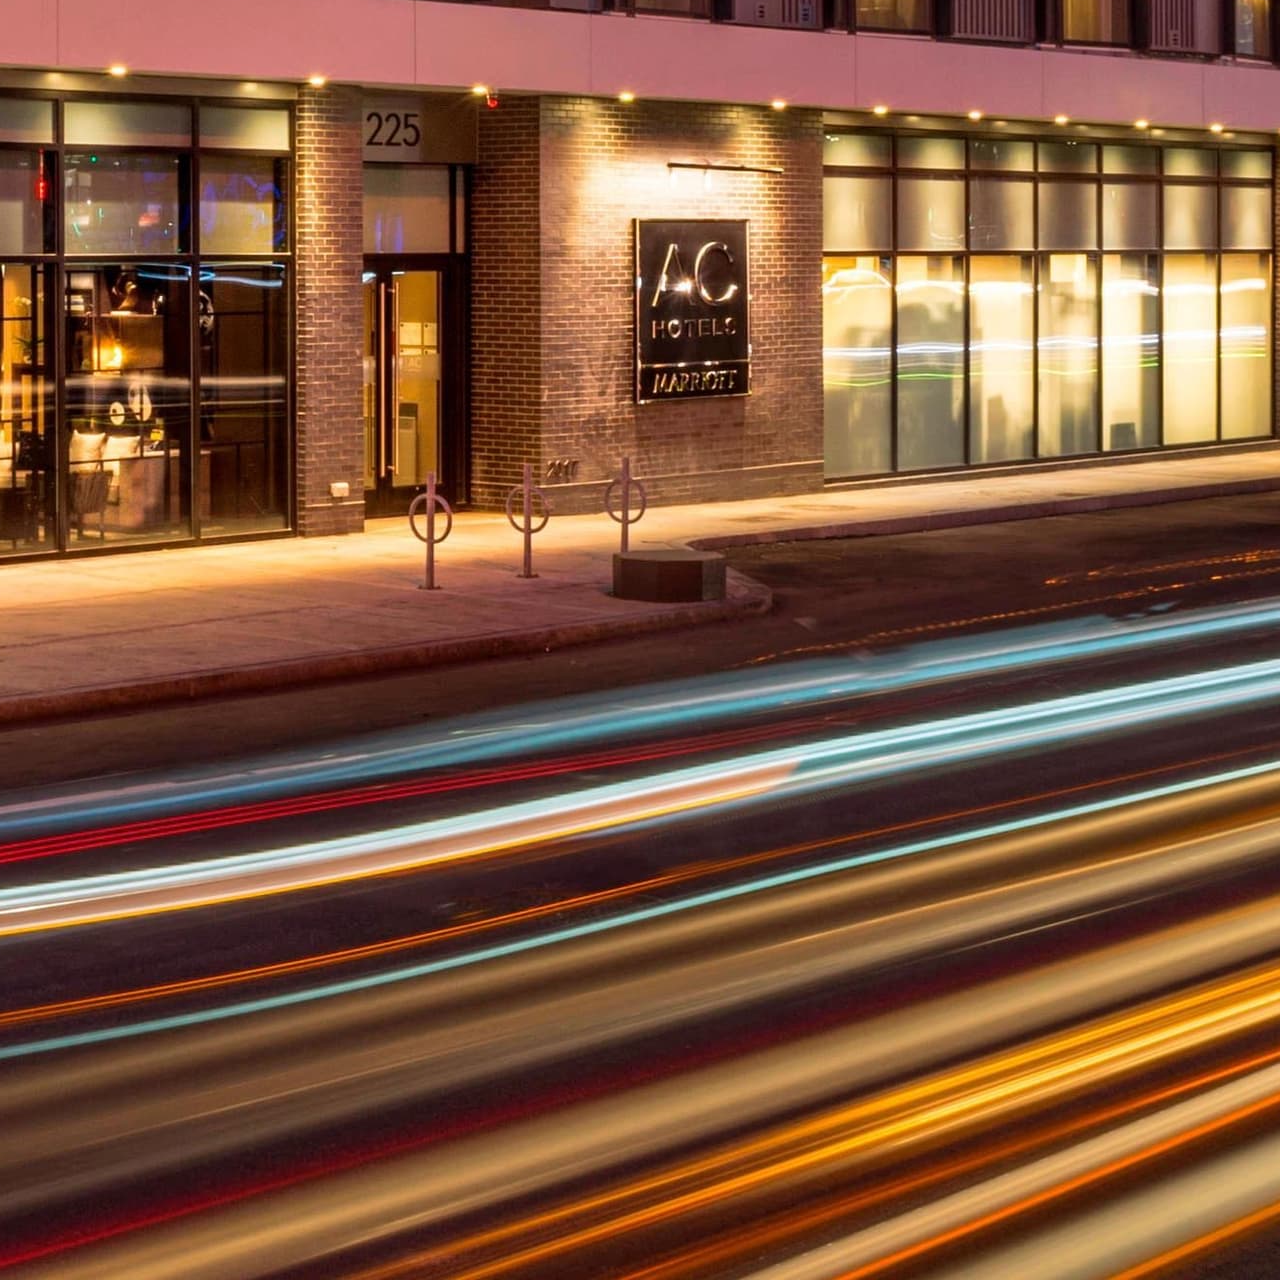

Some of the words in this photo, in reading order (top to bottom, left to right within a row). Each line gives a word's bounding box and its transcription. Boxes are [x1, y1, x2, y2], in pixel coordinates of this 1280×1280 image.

[365, 112, 421, 147] 225
[651, 241, 738, 307] AC
[651, 316, 737, 339] HOTELS
[652, 369, 738, 394] MARRIOTT
